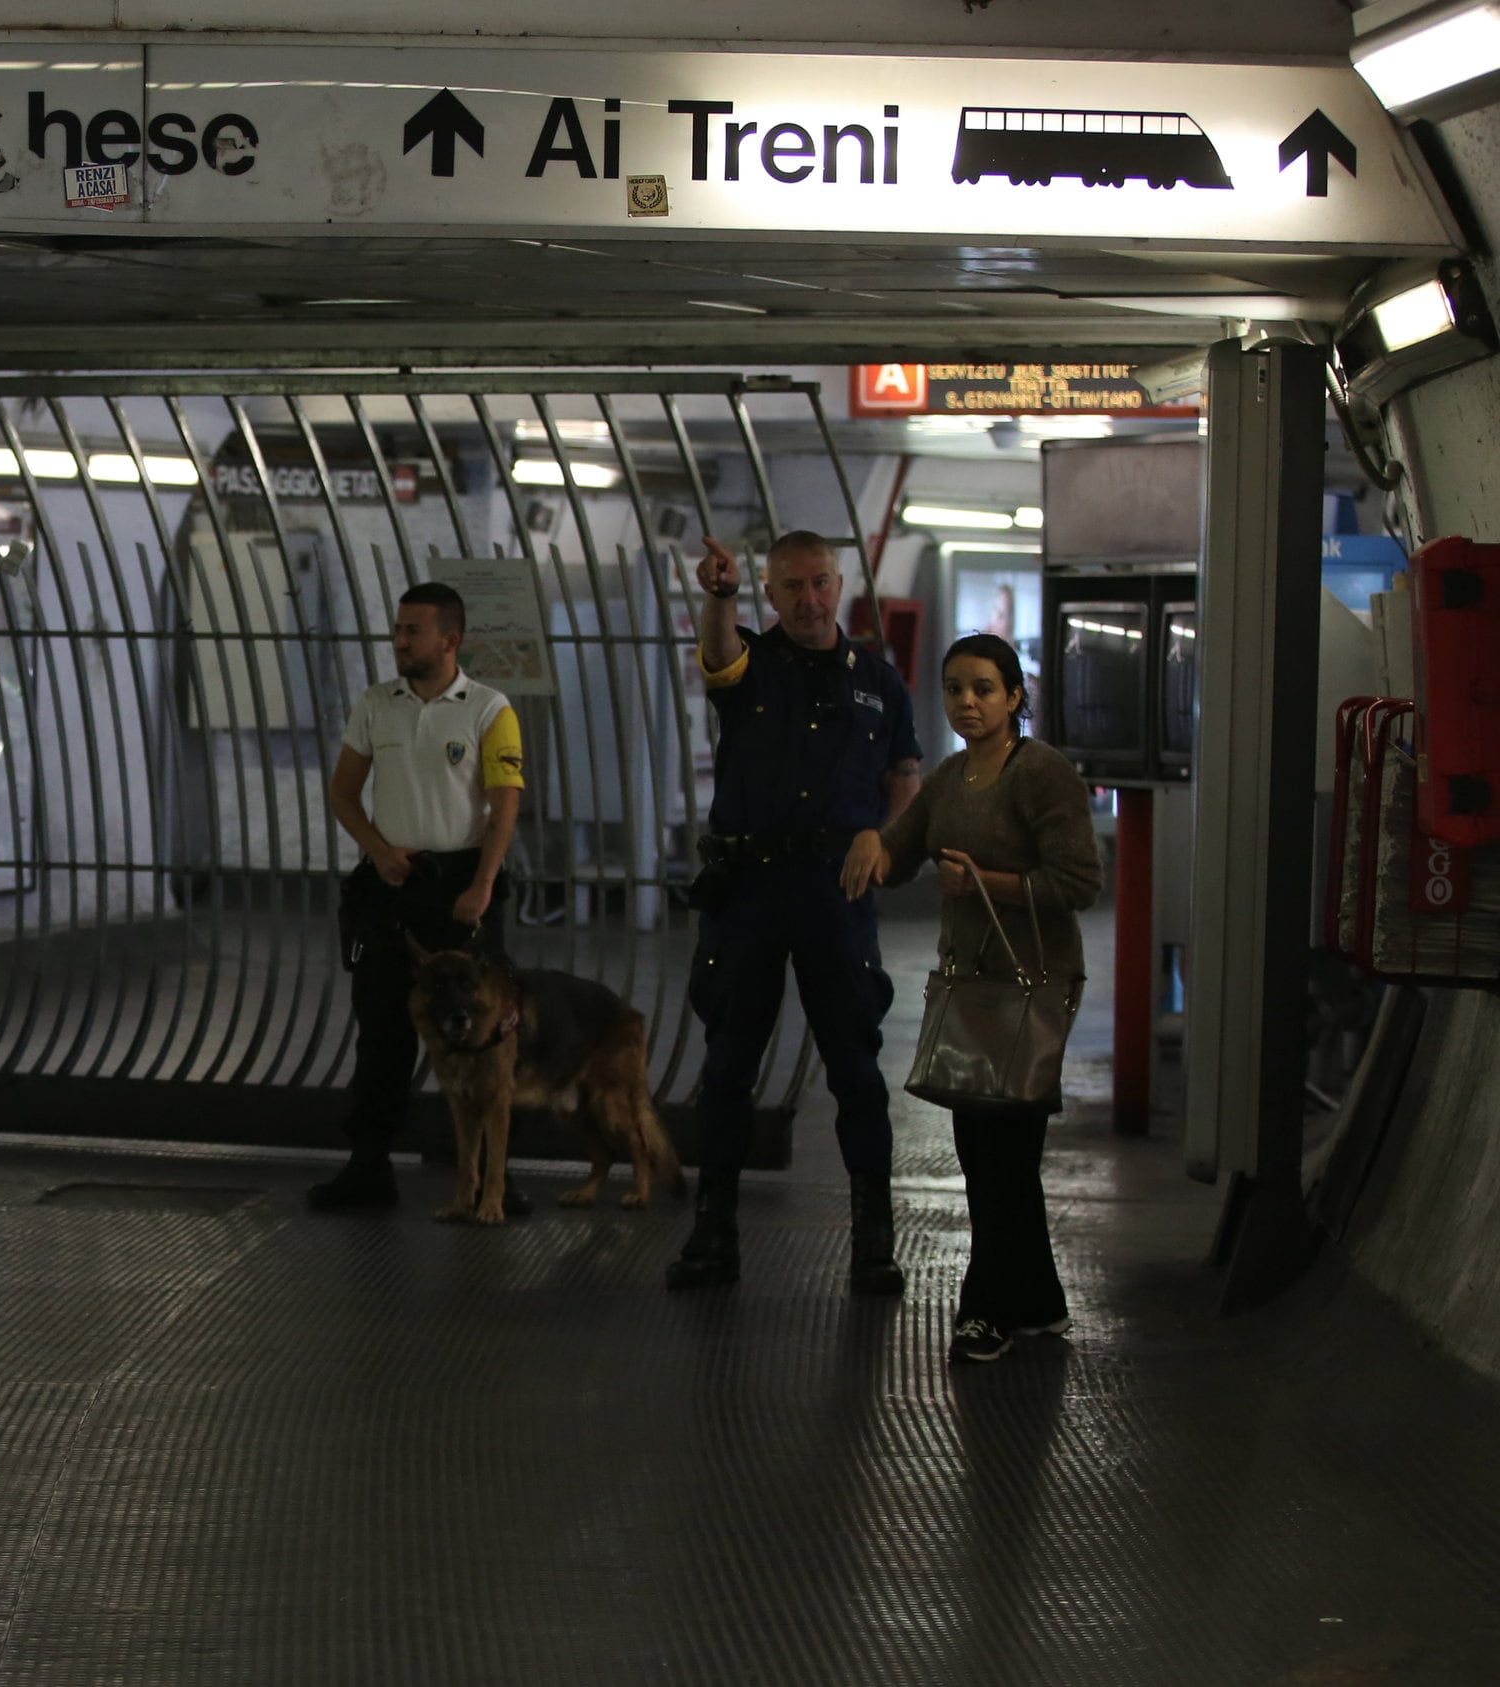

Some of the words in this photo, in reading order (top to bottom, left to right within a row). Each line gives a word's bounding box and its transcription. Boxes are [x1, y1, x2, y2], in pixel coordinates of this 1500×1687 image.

[524, 97, 622, 180] Ai
[668, 99, 900, 185] Treni
[76, 167, 115, 182] RENZI
[78, 183, 86, 198] A
[86, 180, 117, 197] CASA!
[874, 363, 910, 395] A
